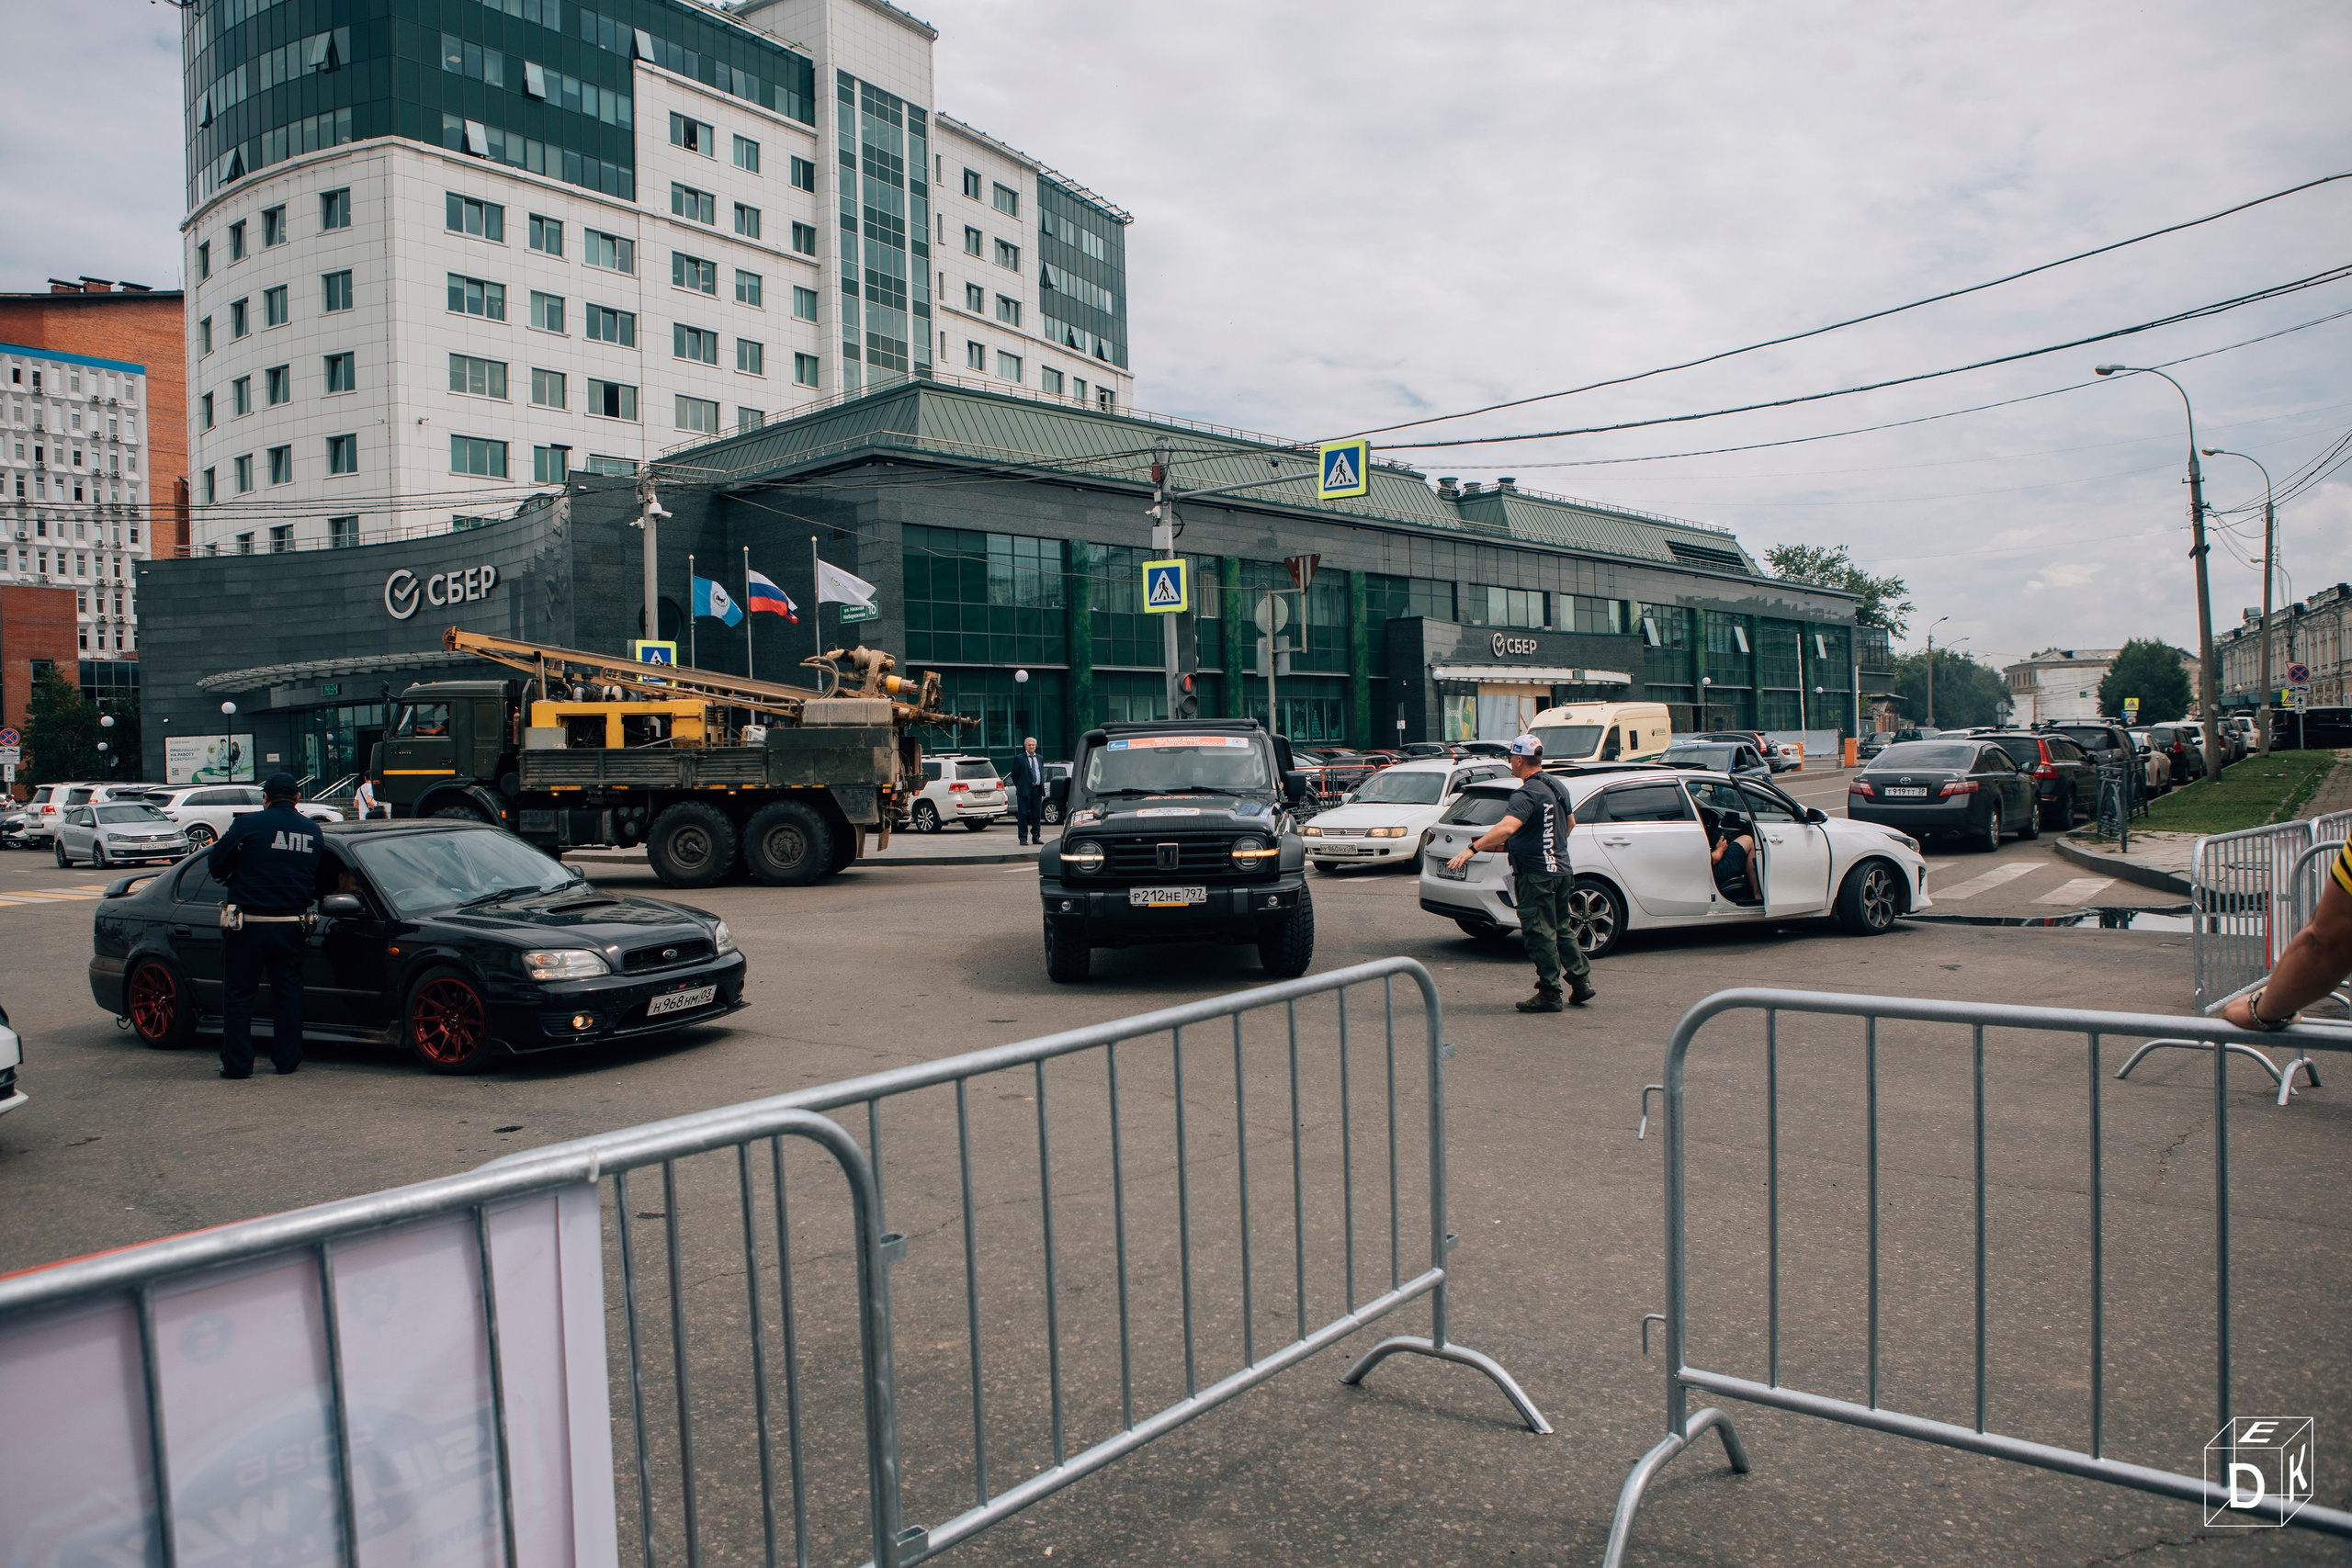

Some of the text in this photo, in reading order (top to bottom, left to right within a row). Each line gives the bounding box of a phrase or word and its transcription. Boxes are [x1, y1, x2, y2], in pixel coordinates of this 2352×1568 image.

[427, 565, 496, 606] СБЕР
[868, 605, 876, 615] 10
[1507, 637, 1537, 654] СБЕР
[271, 830, 313, 853] ДПС
[1543, 802, 1558, 873] SECURITY
[1134, 888, 1203, 902] Р212НЕ 797
[652, 987, 713, 1013] Н968НМ 03
